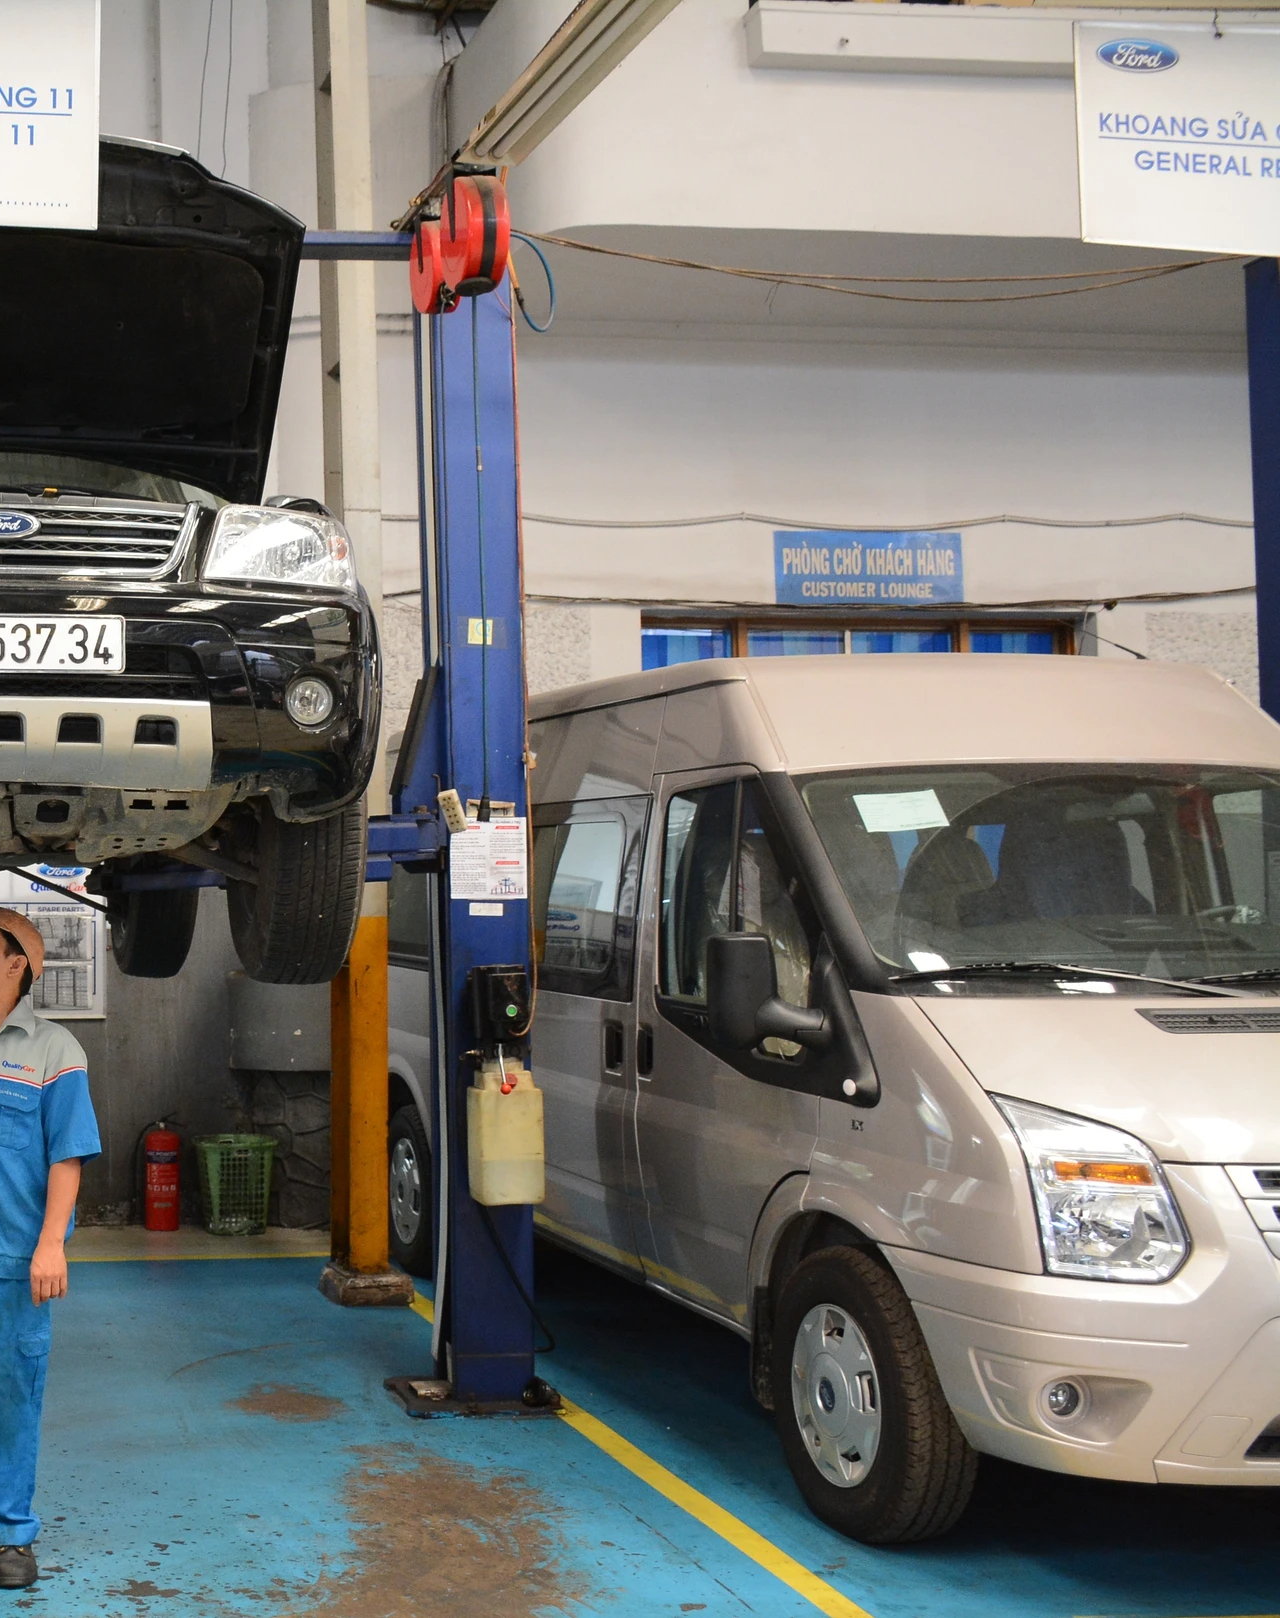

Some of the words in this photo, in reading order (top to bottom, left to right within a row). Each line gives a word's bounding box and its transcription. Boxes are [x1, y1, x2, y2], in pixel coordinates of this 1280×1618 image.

[1112, 43, 1162, 68] Ford
[50, 88, 73, 110] 11
[11, 124, 35, 146] 11
[1098, 112, 1209, 138] KHOANG
[1217, 111, 1268, 141] SỬA
[1134, 150, 1252, 177] GENERAL
[782, 541, 830, 575] PHÒNG
[866, 542, 913, 576] KHÁCH
[917, 542, 955, 576] HÀNG
[801, 581, 876, 598] CUSTOMER
[880, 582, 933, 598] LOUNGE
